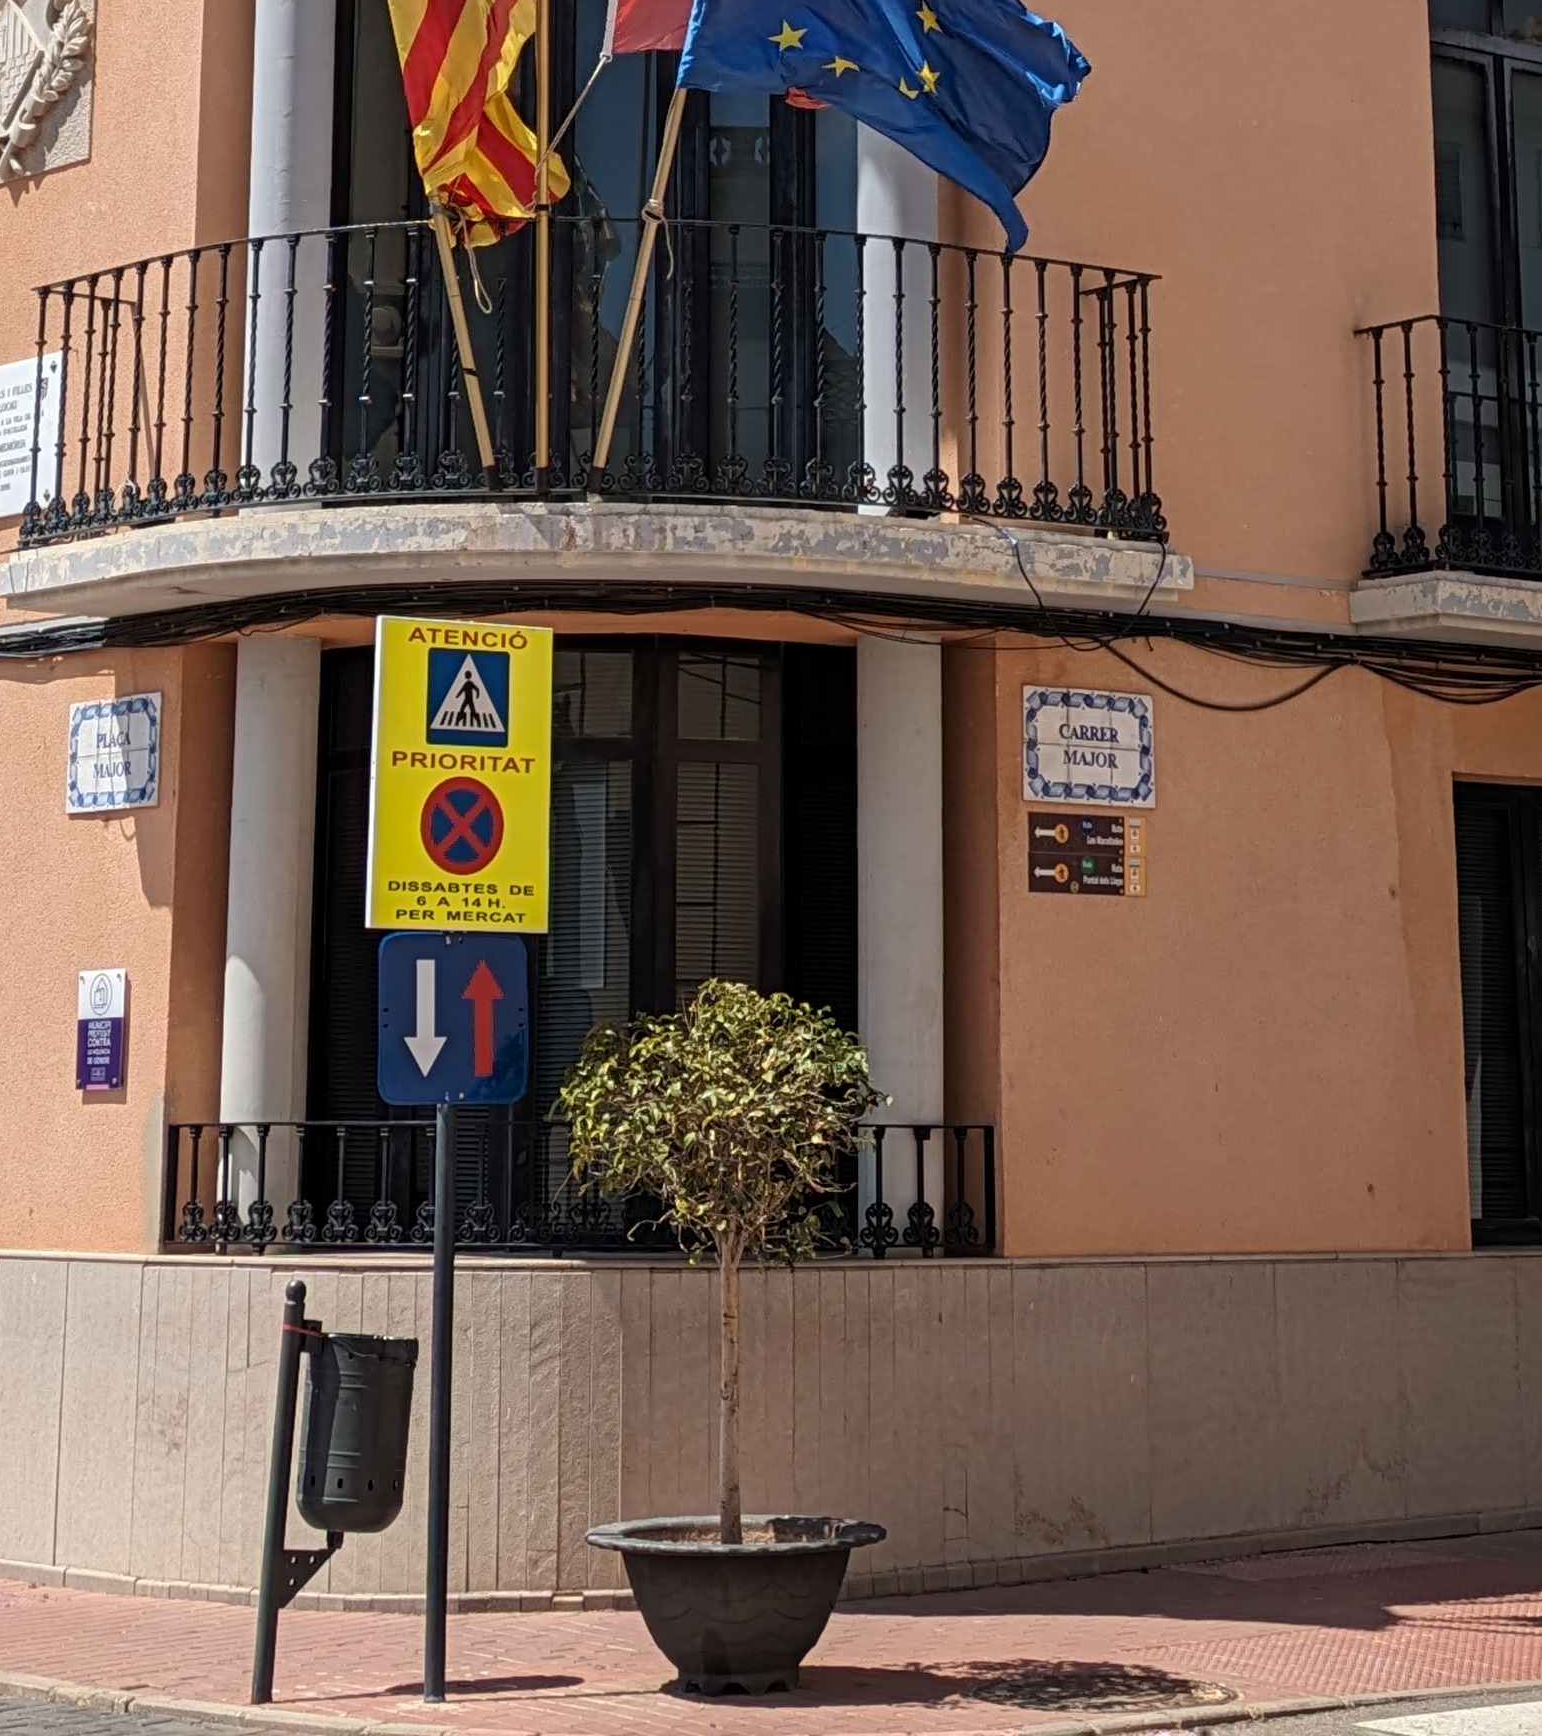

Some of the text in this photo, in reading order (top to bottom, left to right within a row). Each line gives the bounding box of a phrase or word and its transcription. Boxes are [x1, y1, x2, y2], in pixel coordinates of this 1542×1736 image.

[408, 627, 528, 650] ATENCIÓ
[1059, 723, 1119, 743] CARRER
[391, 750, 536, 774] PRIORITAT
[1063, 750, 1119, 769] MAJOR
[93, 761, 132, 778] MAJOR
[388, 881, 535, 896] DISSABTES DE
[416, 895, 427, 906] 6
[437, 896, 450, 907] A
[461, 897, 482, 908] 14
[396, 909, 526, 923] PER MERCAT
